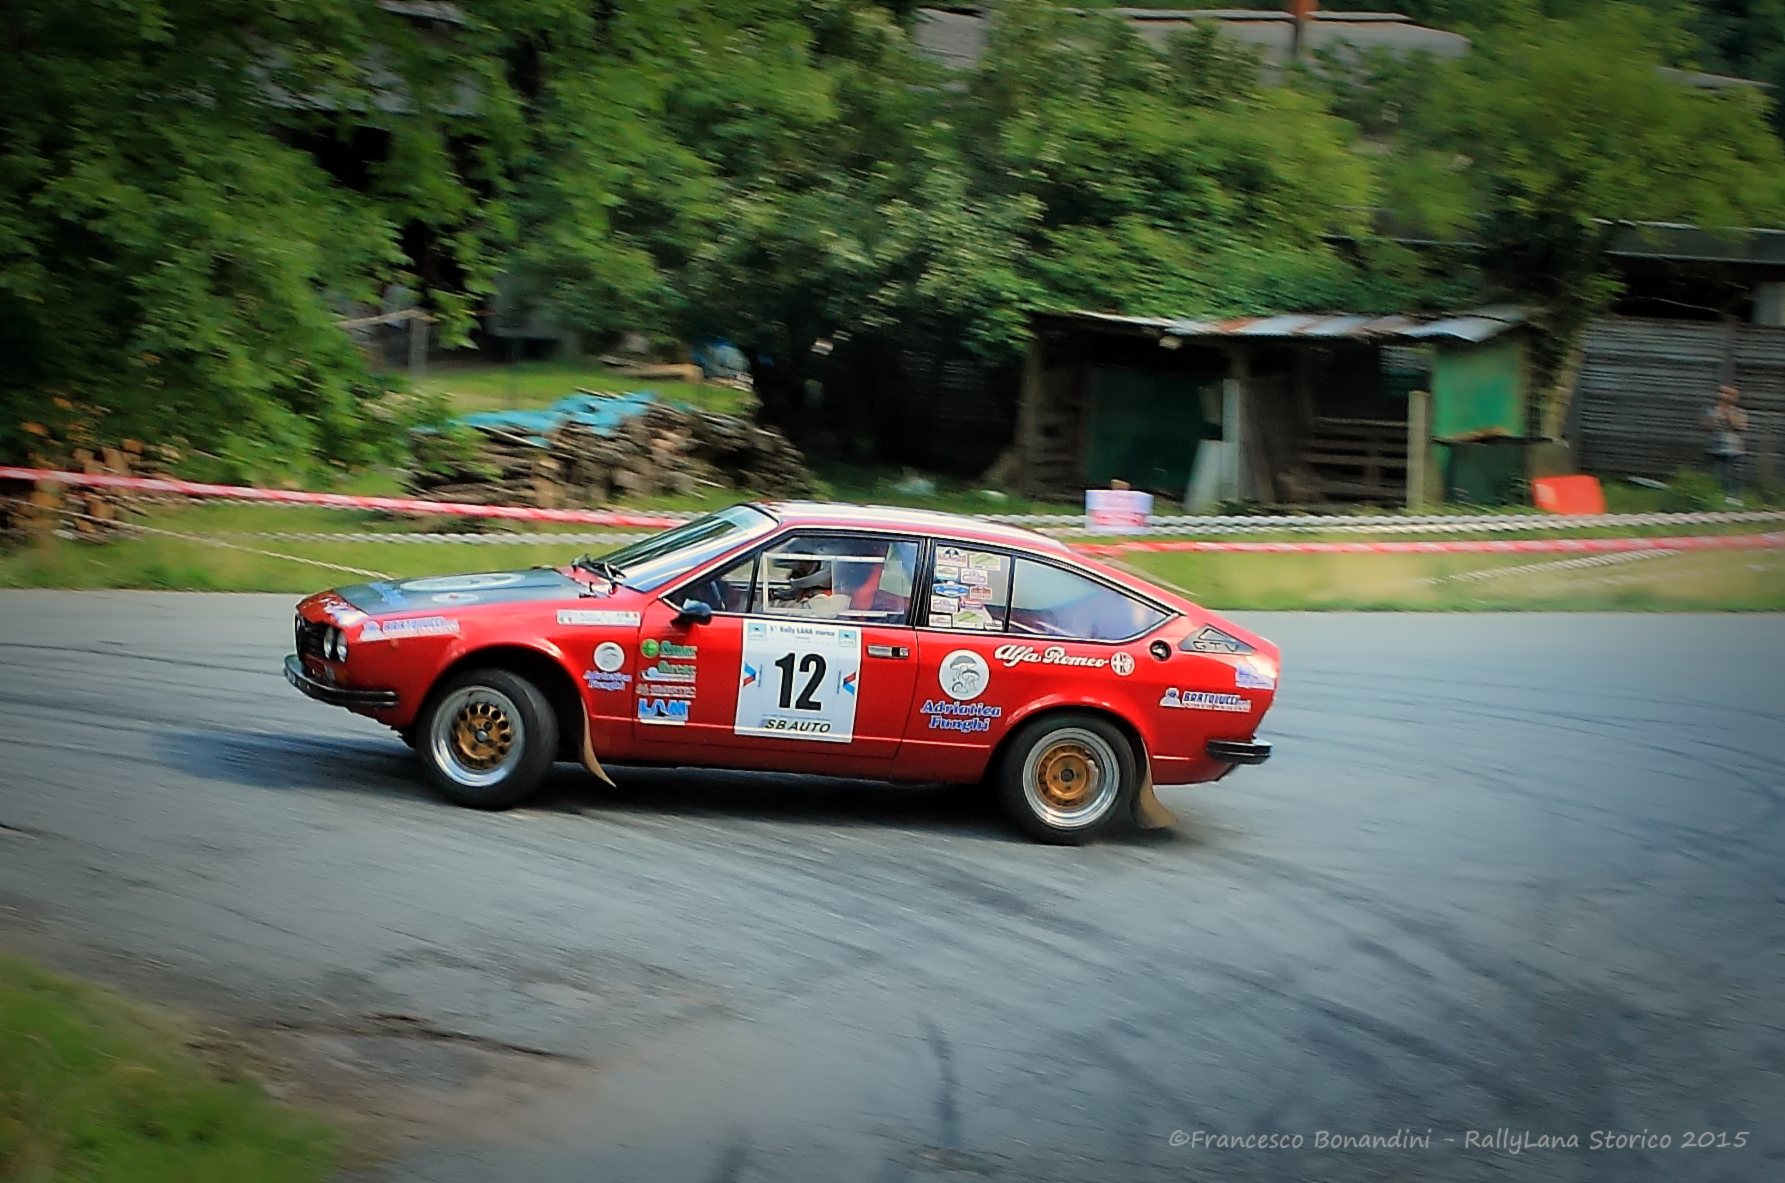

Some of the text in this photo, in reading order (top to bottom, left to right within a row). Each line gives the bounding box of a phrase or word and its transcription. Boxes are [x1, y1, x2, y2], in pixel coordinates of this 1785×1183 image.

[1192, 641, 1239, 653] GTV
[994, 644, 1110, 668] Alfa Romeo
[775, 652, 827, 711] 12
[920, 700, 1002, 717] Adriatica
[765, 719, 831, 733] SB AUTO
[929, 715, 990, 733] Funghi
